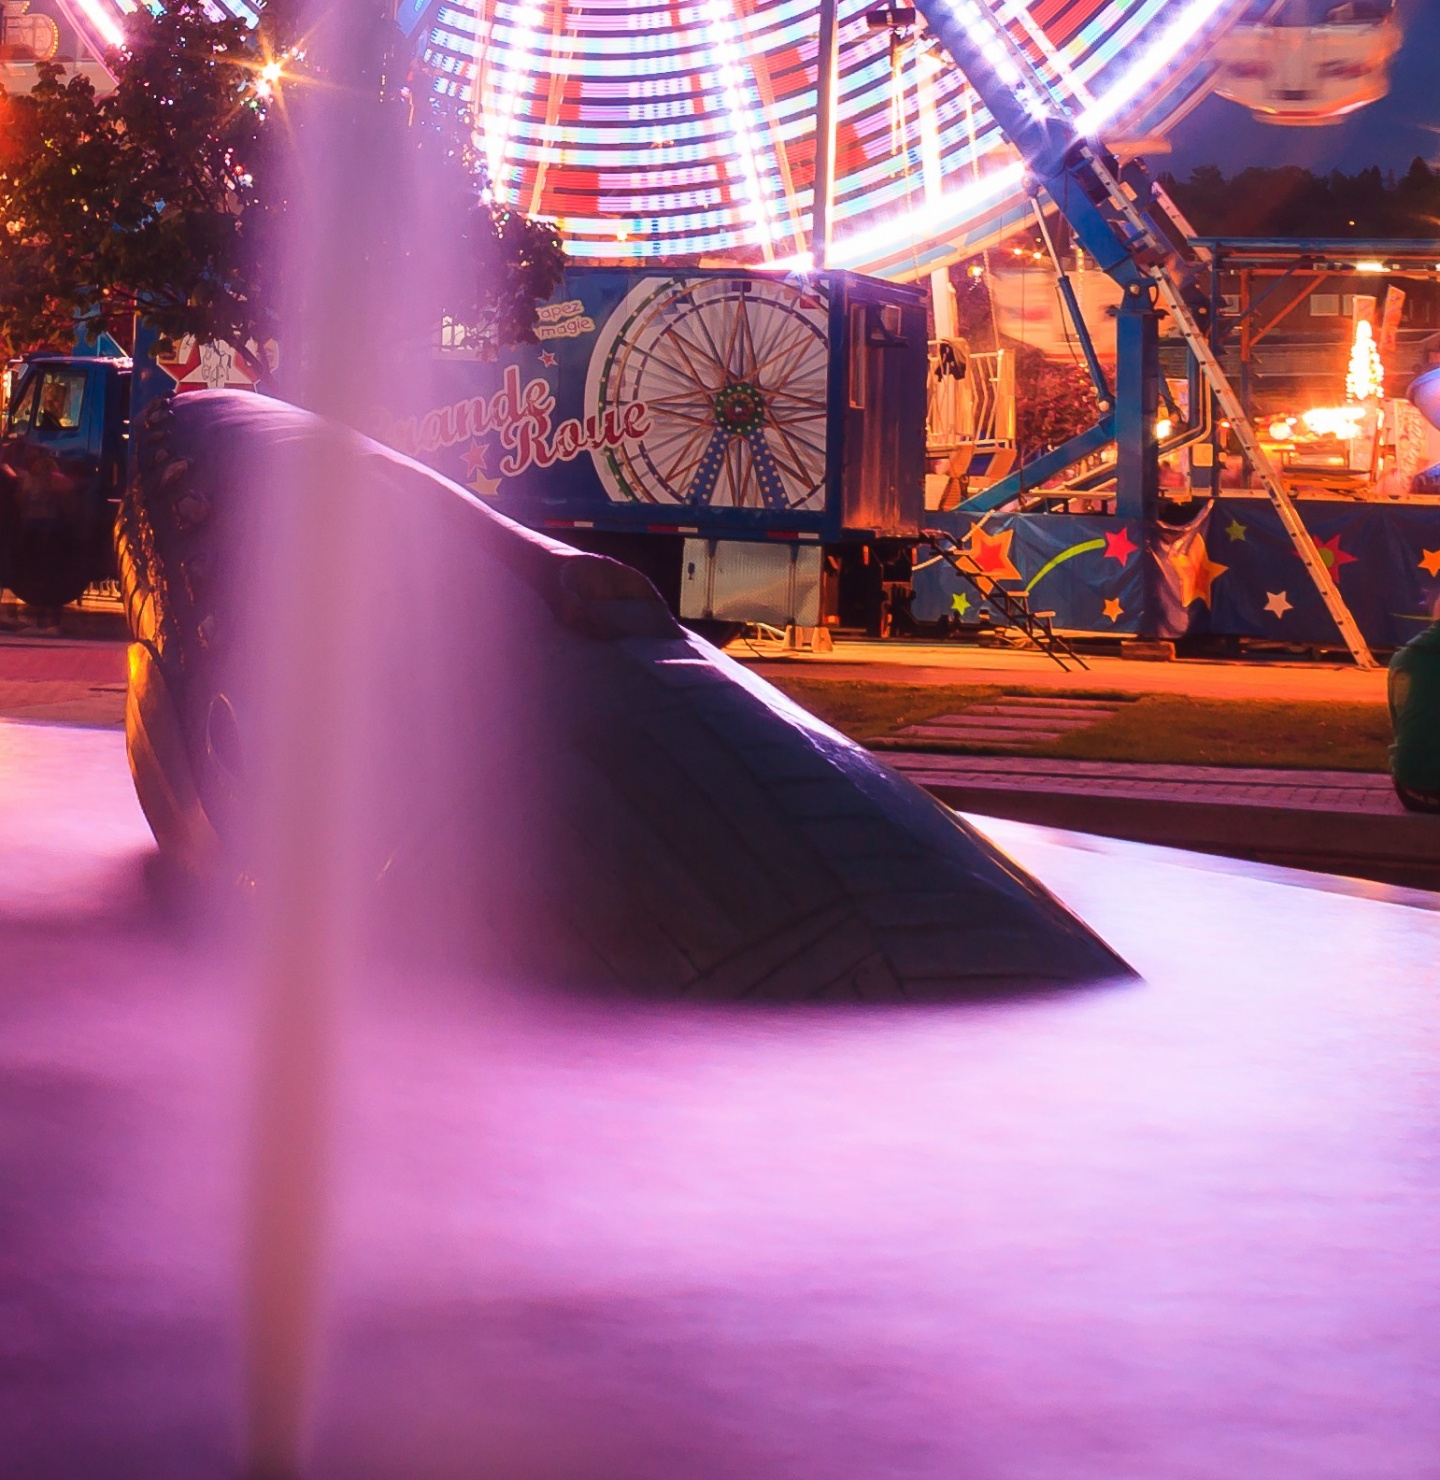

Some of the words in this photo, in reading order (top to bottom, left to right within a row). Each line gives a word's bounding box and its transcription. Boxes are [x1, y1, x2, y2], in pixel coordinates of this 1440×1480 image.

[539, 302, 580, 319] apez
[541, 318, 592, 336] magie
[502, 402, 652, 475] Roue
